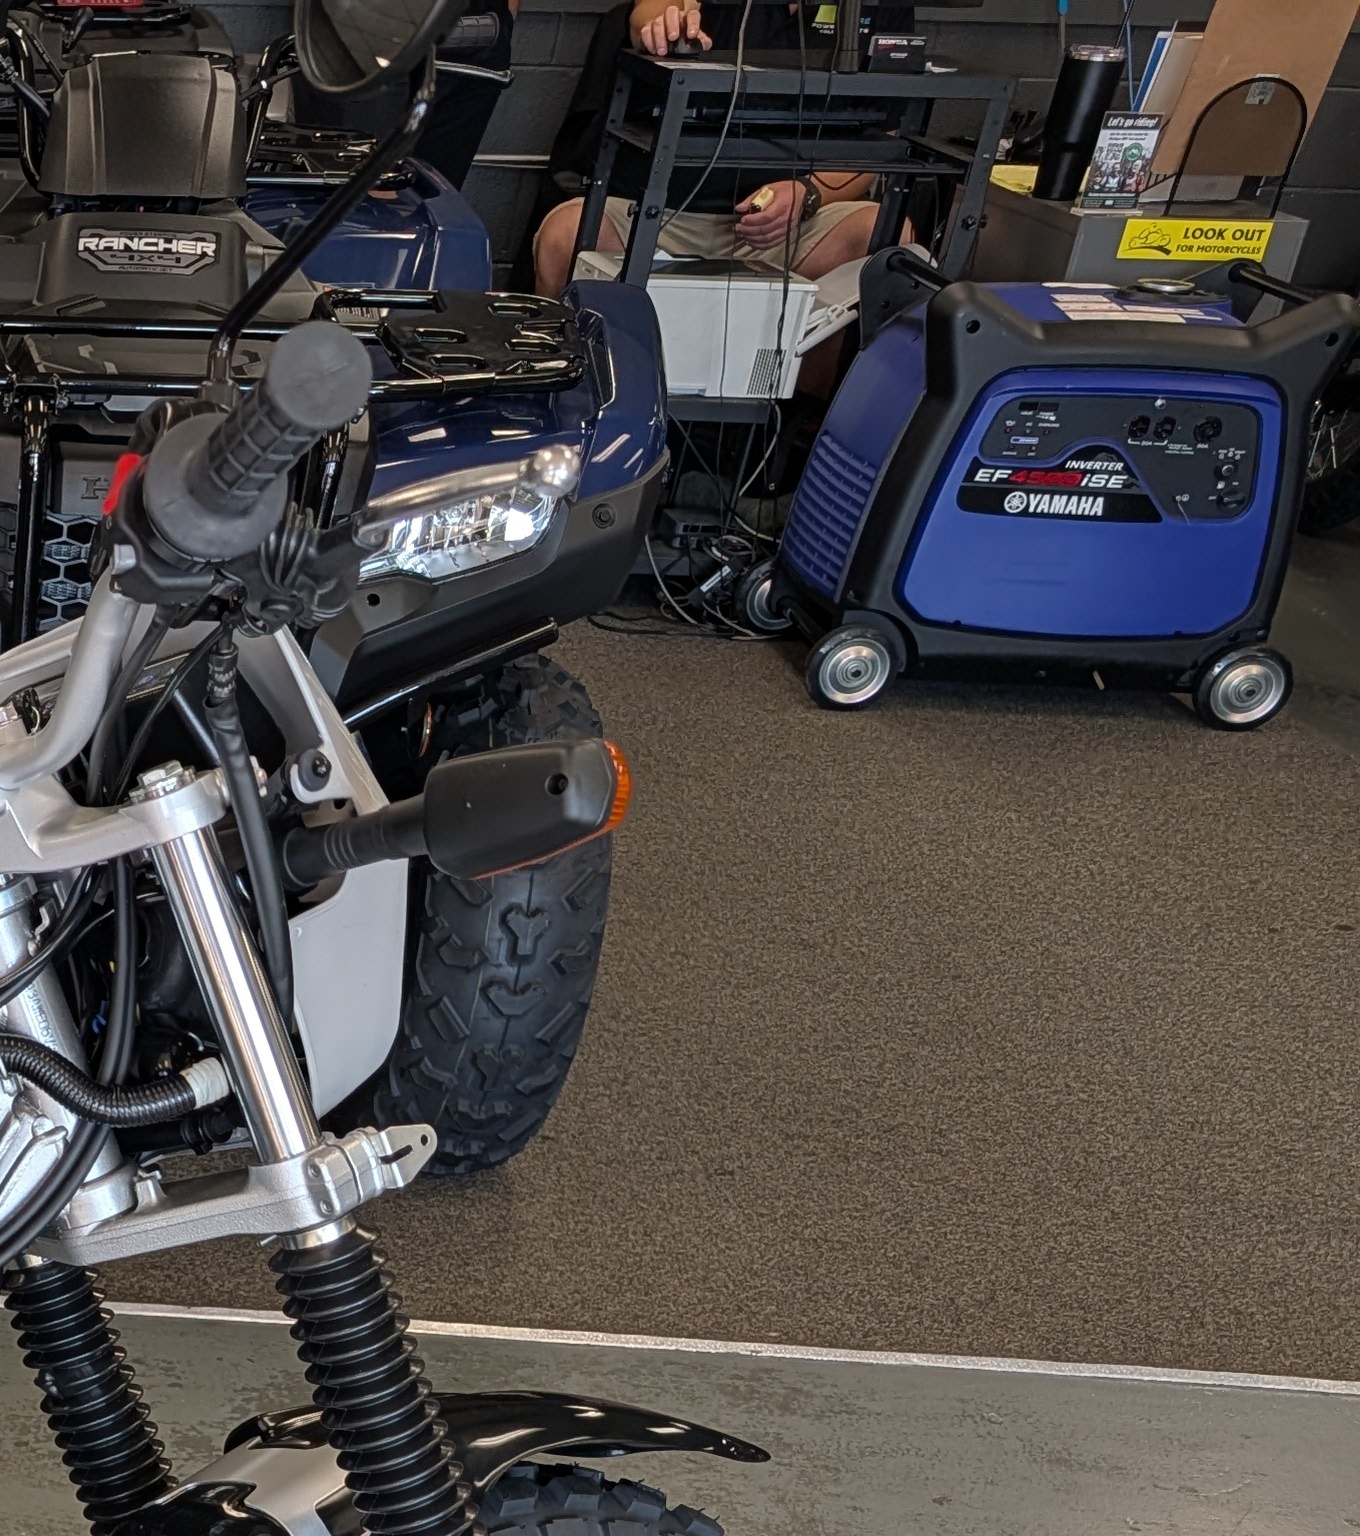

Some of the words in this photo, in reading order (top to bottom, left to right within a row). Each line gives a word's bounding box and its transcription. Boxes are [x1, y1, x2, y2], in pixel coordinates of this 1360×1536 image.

[1107, 117, 1123, 127] Let's
[1134, 117, 1158, 128] riding!
[1182, 226, 1229, 241] LOOK
[1231, 228, 1266, 242] OUT
[78, 237, 216, 257] RANCHER
[1175, 243, 1194, 253] FOR
[1196, 245, 1262, 255] MOTORCYCLES
[1065, 460, 1124, 471] INVERTER
[973, 468, 1129, 488] EF4500iSE
[1027, 493, 1105, 516] YAMAHA
